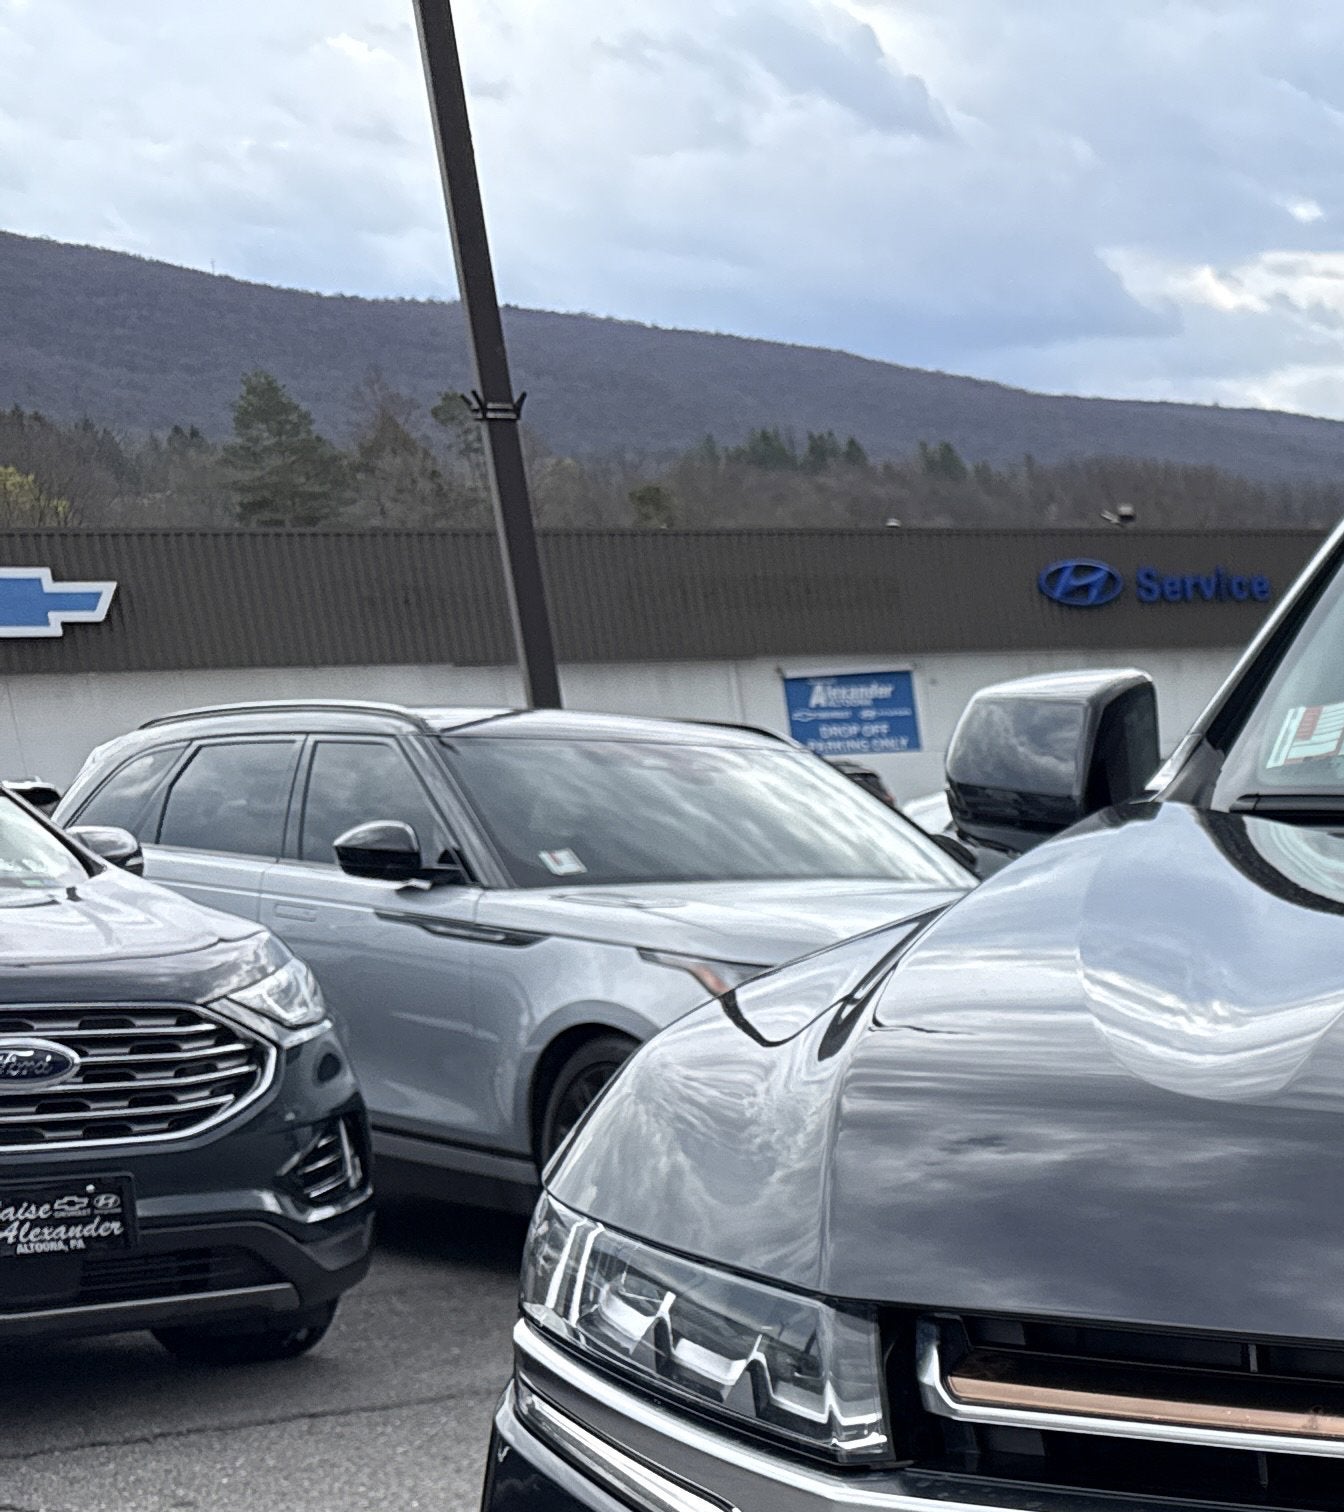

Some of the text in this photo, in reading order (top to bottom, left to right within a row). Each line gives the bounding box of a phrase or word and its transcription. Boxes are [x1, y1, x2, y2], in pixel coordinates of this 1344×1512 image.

[1136, 566, 1270, 602] Service
[819, 720, 889, 739] DROP OFF
[0, 1215, 124, 1244] Alexander
